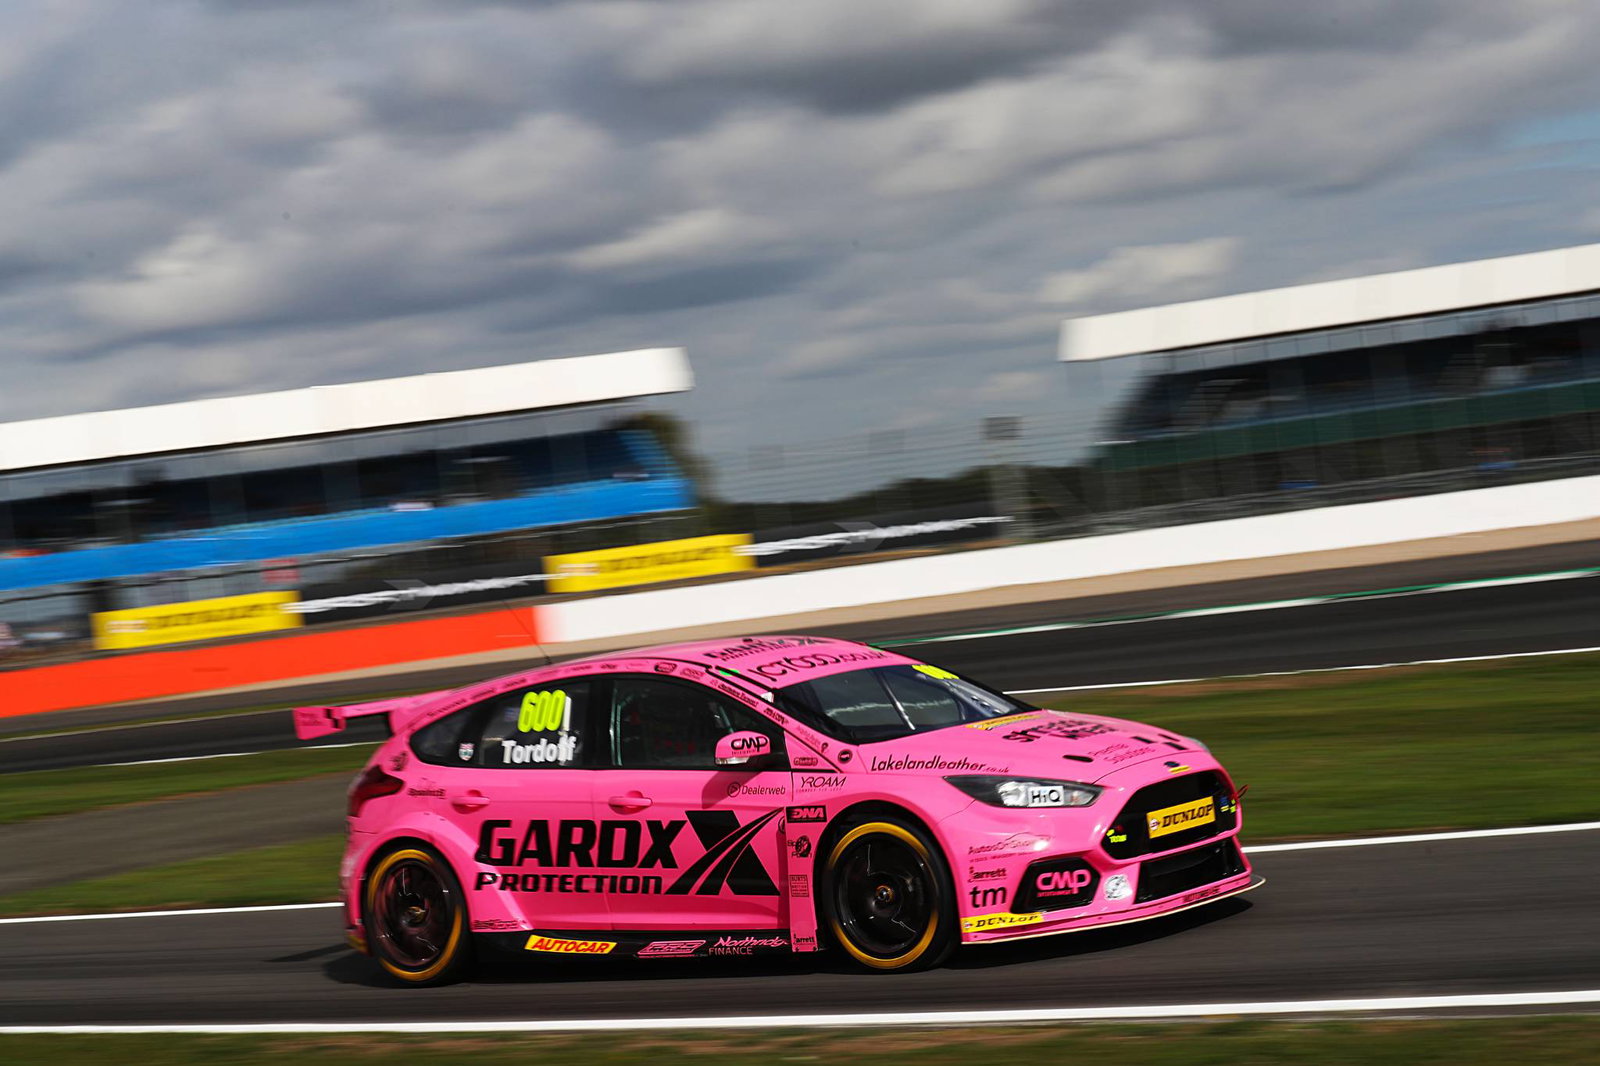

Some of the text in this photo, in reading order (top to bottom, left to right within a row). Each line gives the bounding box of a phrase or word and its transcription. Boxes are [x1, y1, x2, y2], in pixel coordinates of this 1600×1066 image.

[517, 689, 568, 733] 600
[502, 735, 577, 765] Tordoff
[741, 784, 786, 796] Dealerweb
[1162, 804, 1213, 828] DUNLOP
[474, 819, 687, 869] GARDX
[1036, 869, 1092, 894] CMP
[969, 886, 1007, 908] tm
[975, 915, 1039, 928] DUNLOP
[532, 938, 610, 953] AUTOCAR
[708, 946, 754, 957] FINANCE
